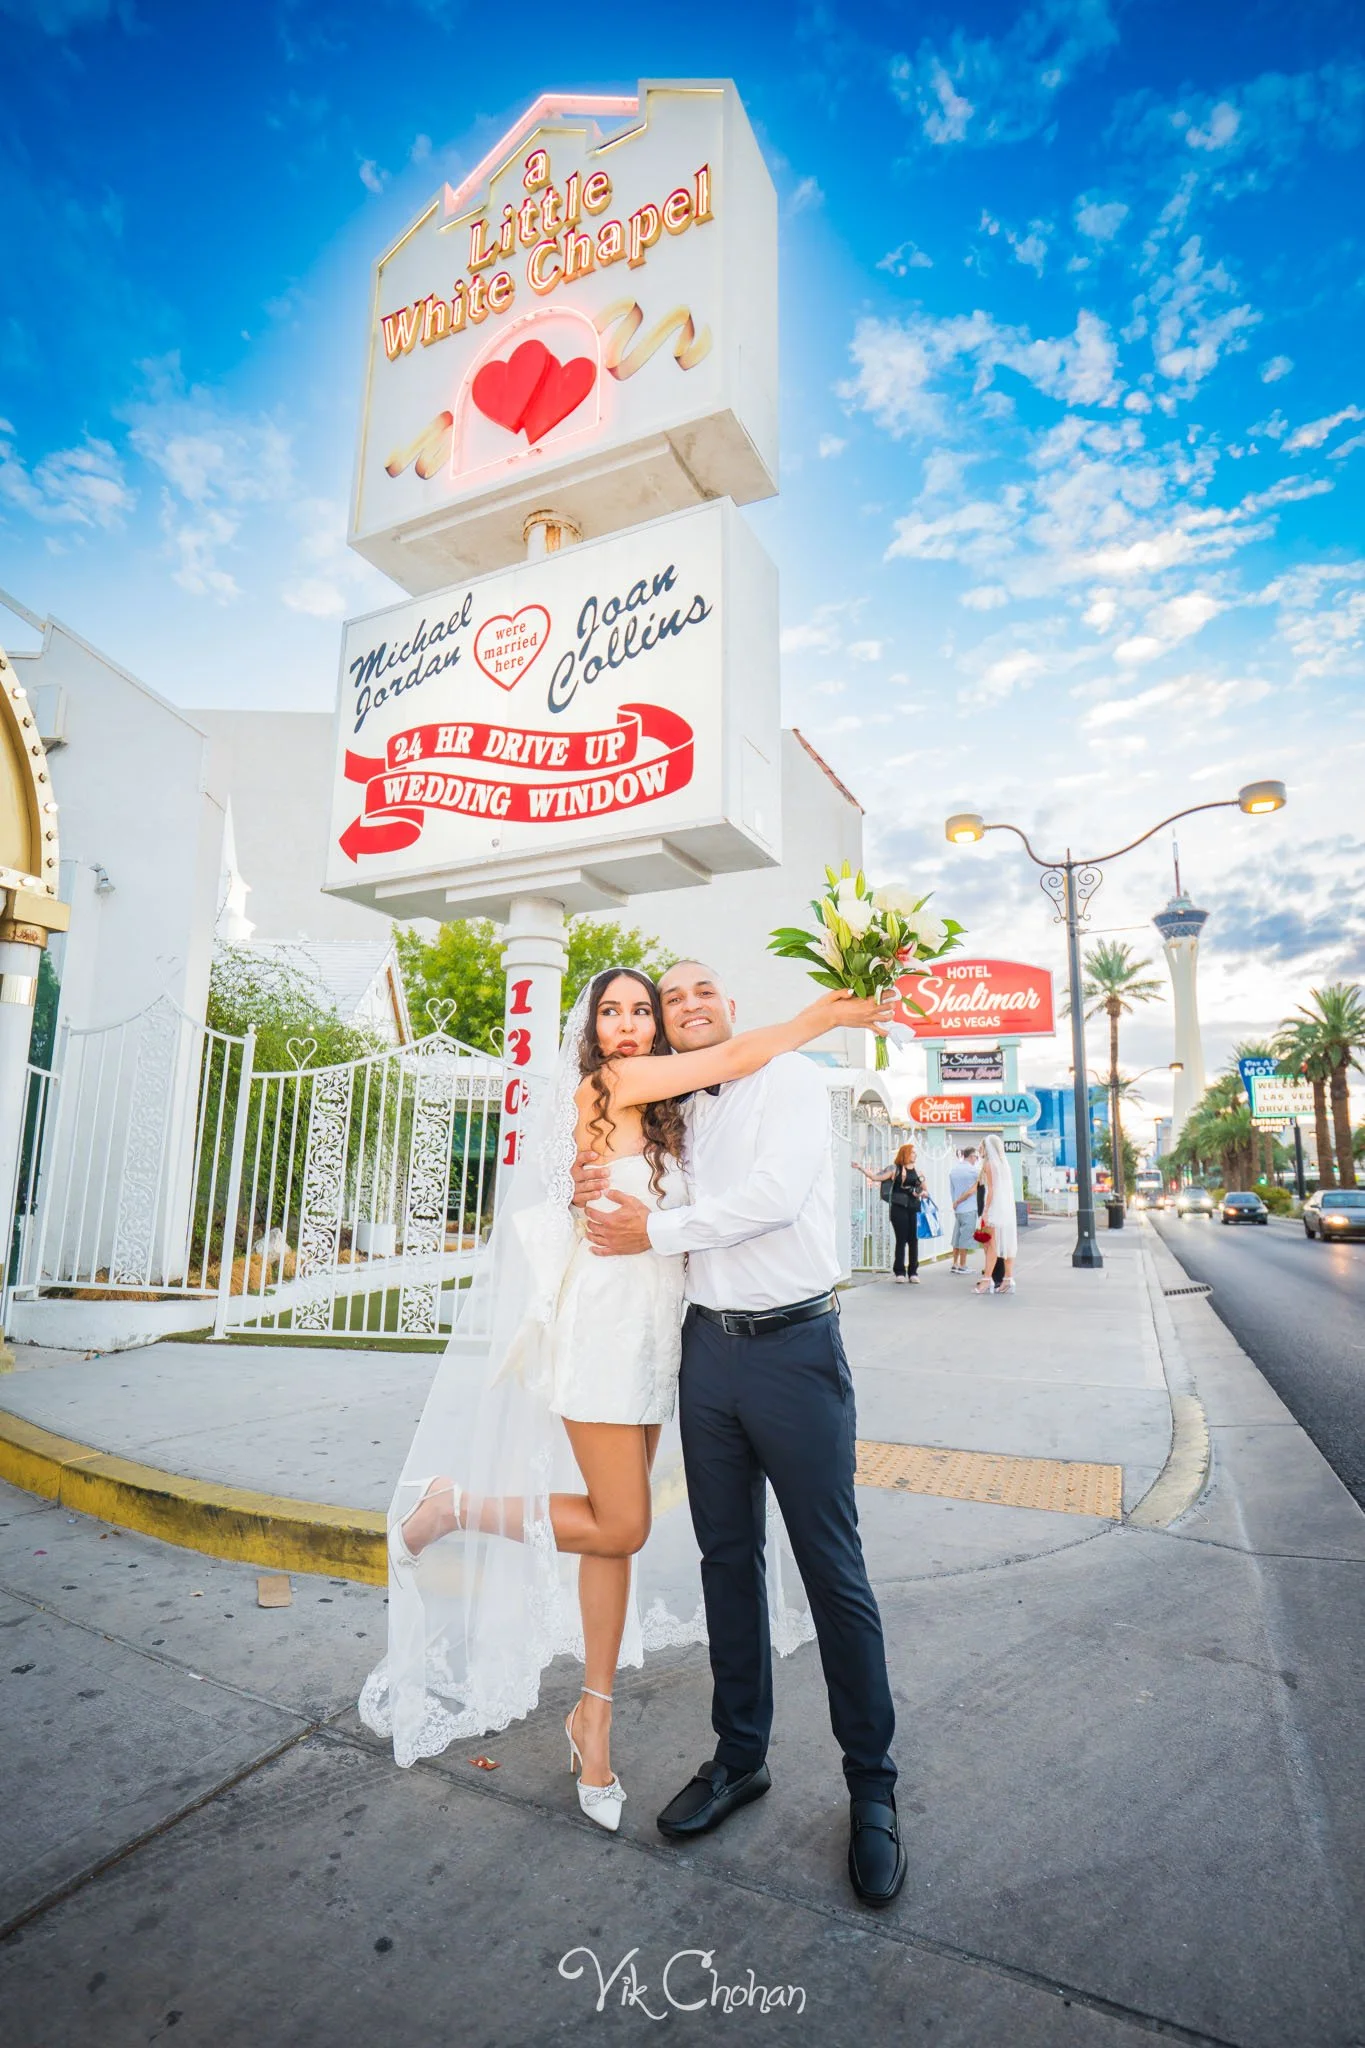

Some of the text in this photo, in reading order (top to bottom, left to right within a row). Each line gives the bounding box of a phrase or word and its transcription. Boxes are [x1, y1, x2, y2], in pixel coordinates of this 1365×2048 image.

[524, 149, 550, 193] a
[467, 171, 613, 272] Little
[381, 163, 714, 362] White Chapel
[576, 564, 678, 662] Joan
[349, 592, 474, 689] Michael
[495, 620, 527, 642] were
[483, 632, 538, 660] married
[547, 594, 713, 714] Collins
[494, 653, 525, 673] here
[354, 646, 462, 733] Jordan
[395, 726, 626, 767] 24 HR DRIVE UP
[383, 760, 669, 818] WEDDING WINDOW
[947, 965, 992, 979] HOTEL
[902, 976, 1041, 1018] Shalimar
[941, 1016, 1001, 1029] LAS VEGAS
[950, 1053, 994, 1065] Shalimar
[1244, 1067, 1275, 1076] MOT
[919, 1098, 965, 1112] Shalimar
[976, 1099, 1029, 1114] AQUA
[1292, 1092, 1313, 1100] VEG
[920, 1111, 965, 1122] HOTEL
[1005, 1142, 1020, 1151] 1401
